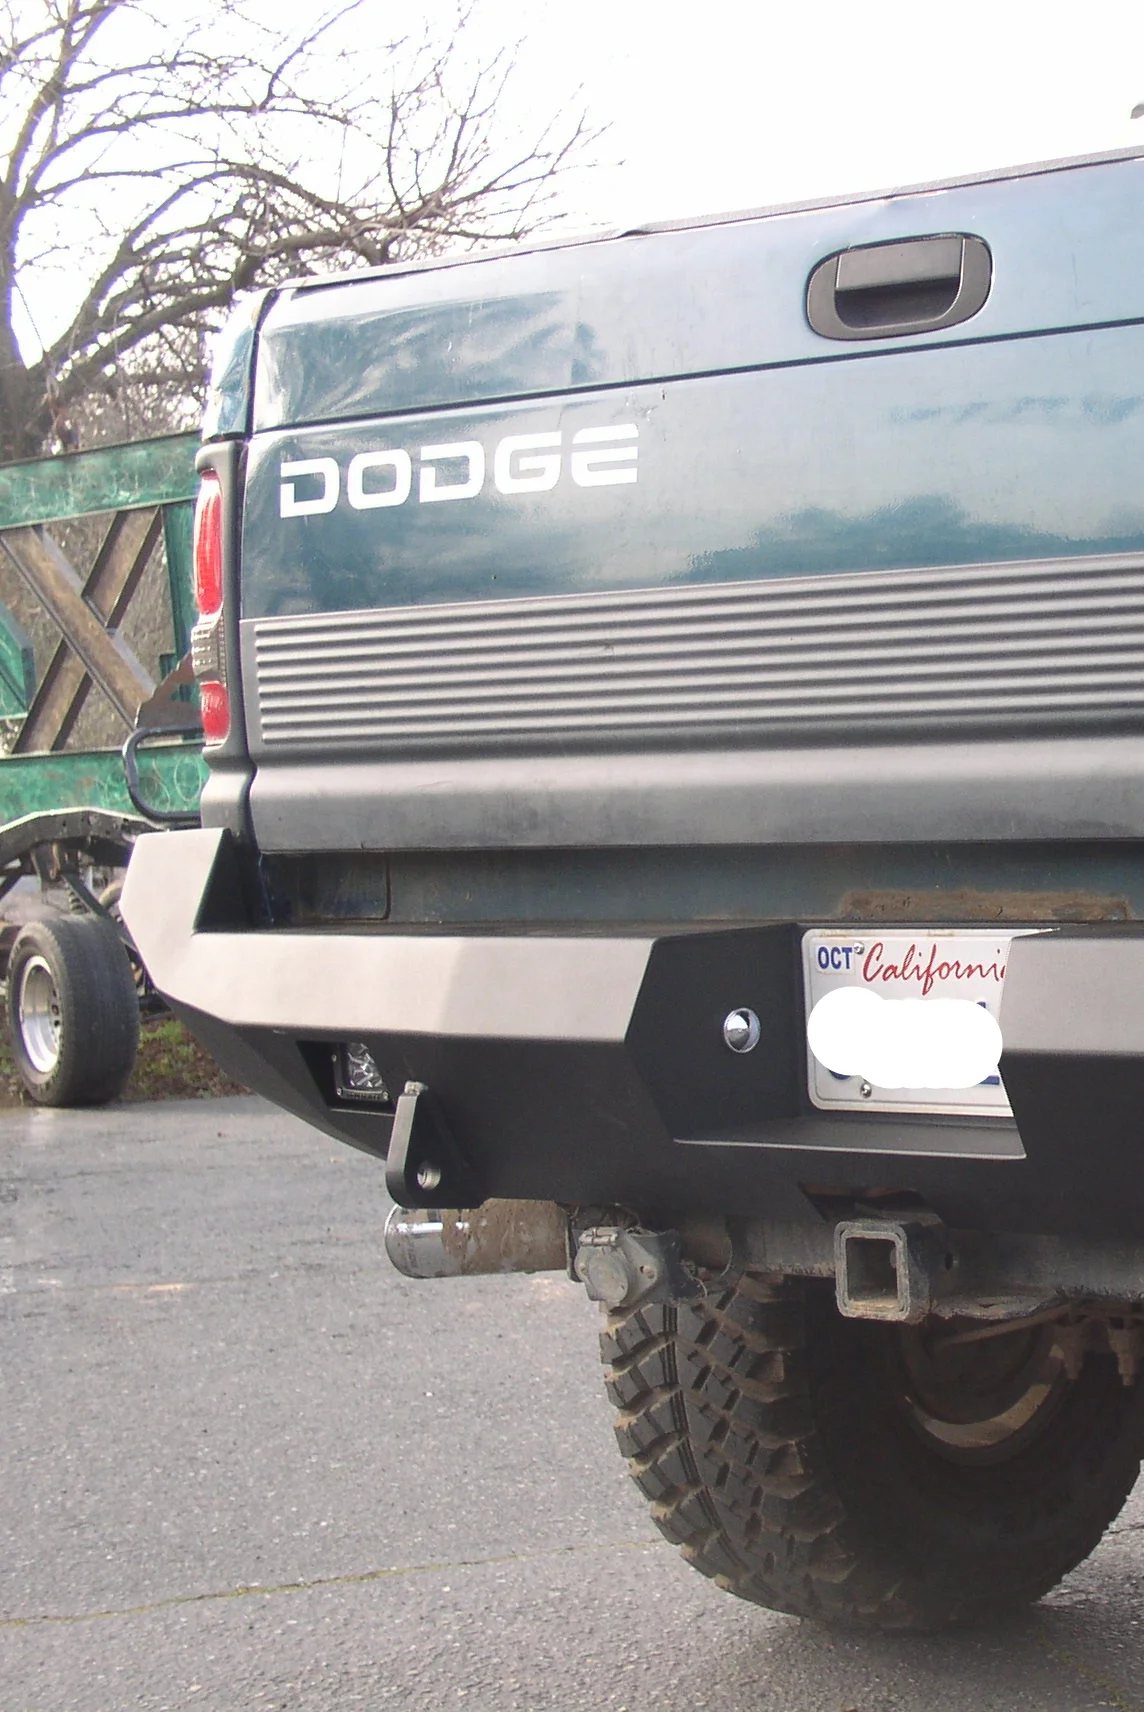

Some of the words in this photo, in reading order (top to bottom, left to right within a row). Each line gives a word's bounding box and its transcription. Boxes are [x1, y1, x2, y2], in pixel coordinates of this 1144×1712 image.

[279, 423, 640, 519] DODGE
[818, 946, 852, 970] OCT
[863, 942, 1006, 996] Californi
